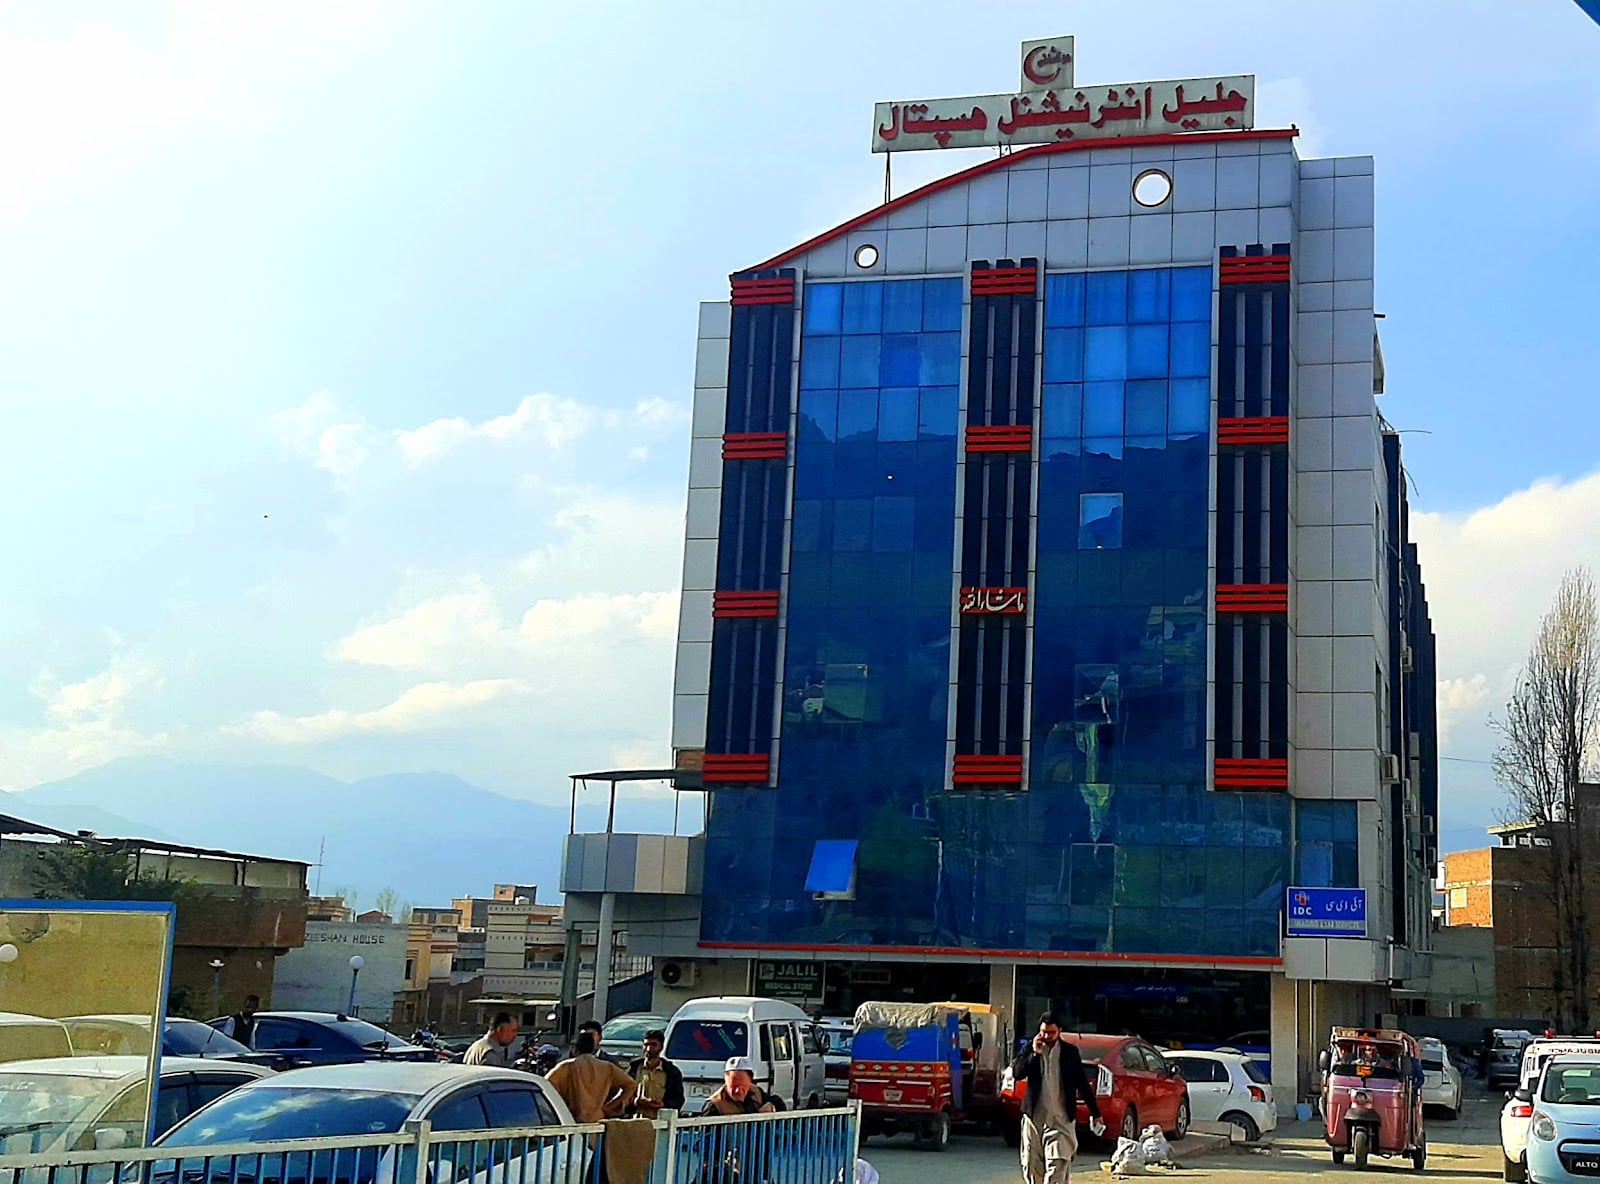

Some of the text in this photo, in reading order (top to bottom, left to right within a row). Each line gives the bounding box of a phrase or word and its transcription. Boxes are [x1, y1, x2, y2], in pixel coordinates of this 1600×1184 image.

[1293, 906, 1312, 916] IDC
[353, 934, 385, 944] HOUSE
[777, 964, 818, 977] JALIL
[1576, 1161, 1598, 1169] ALTO
